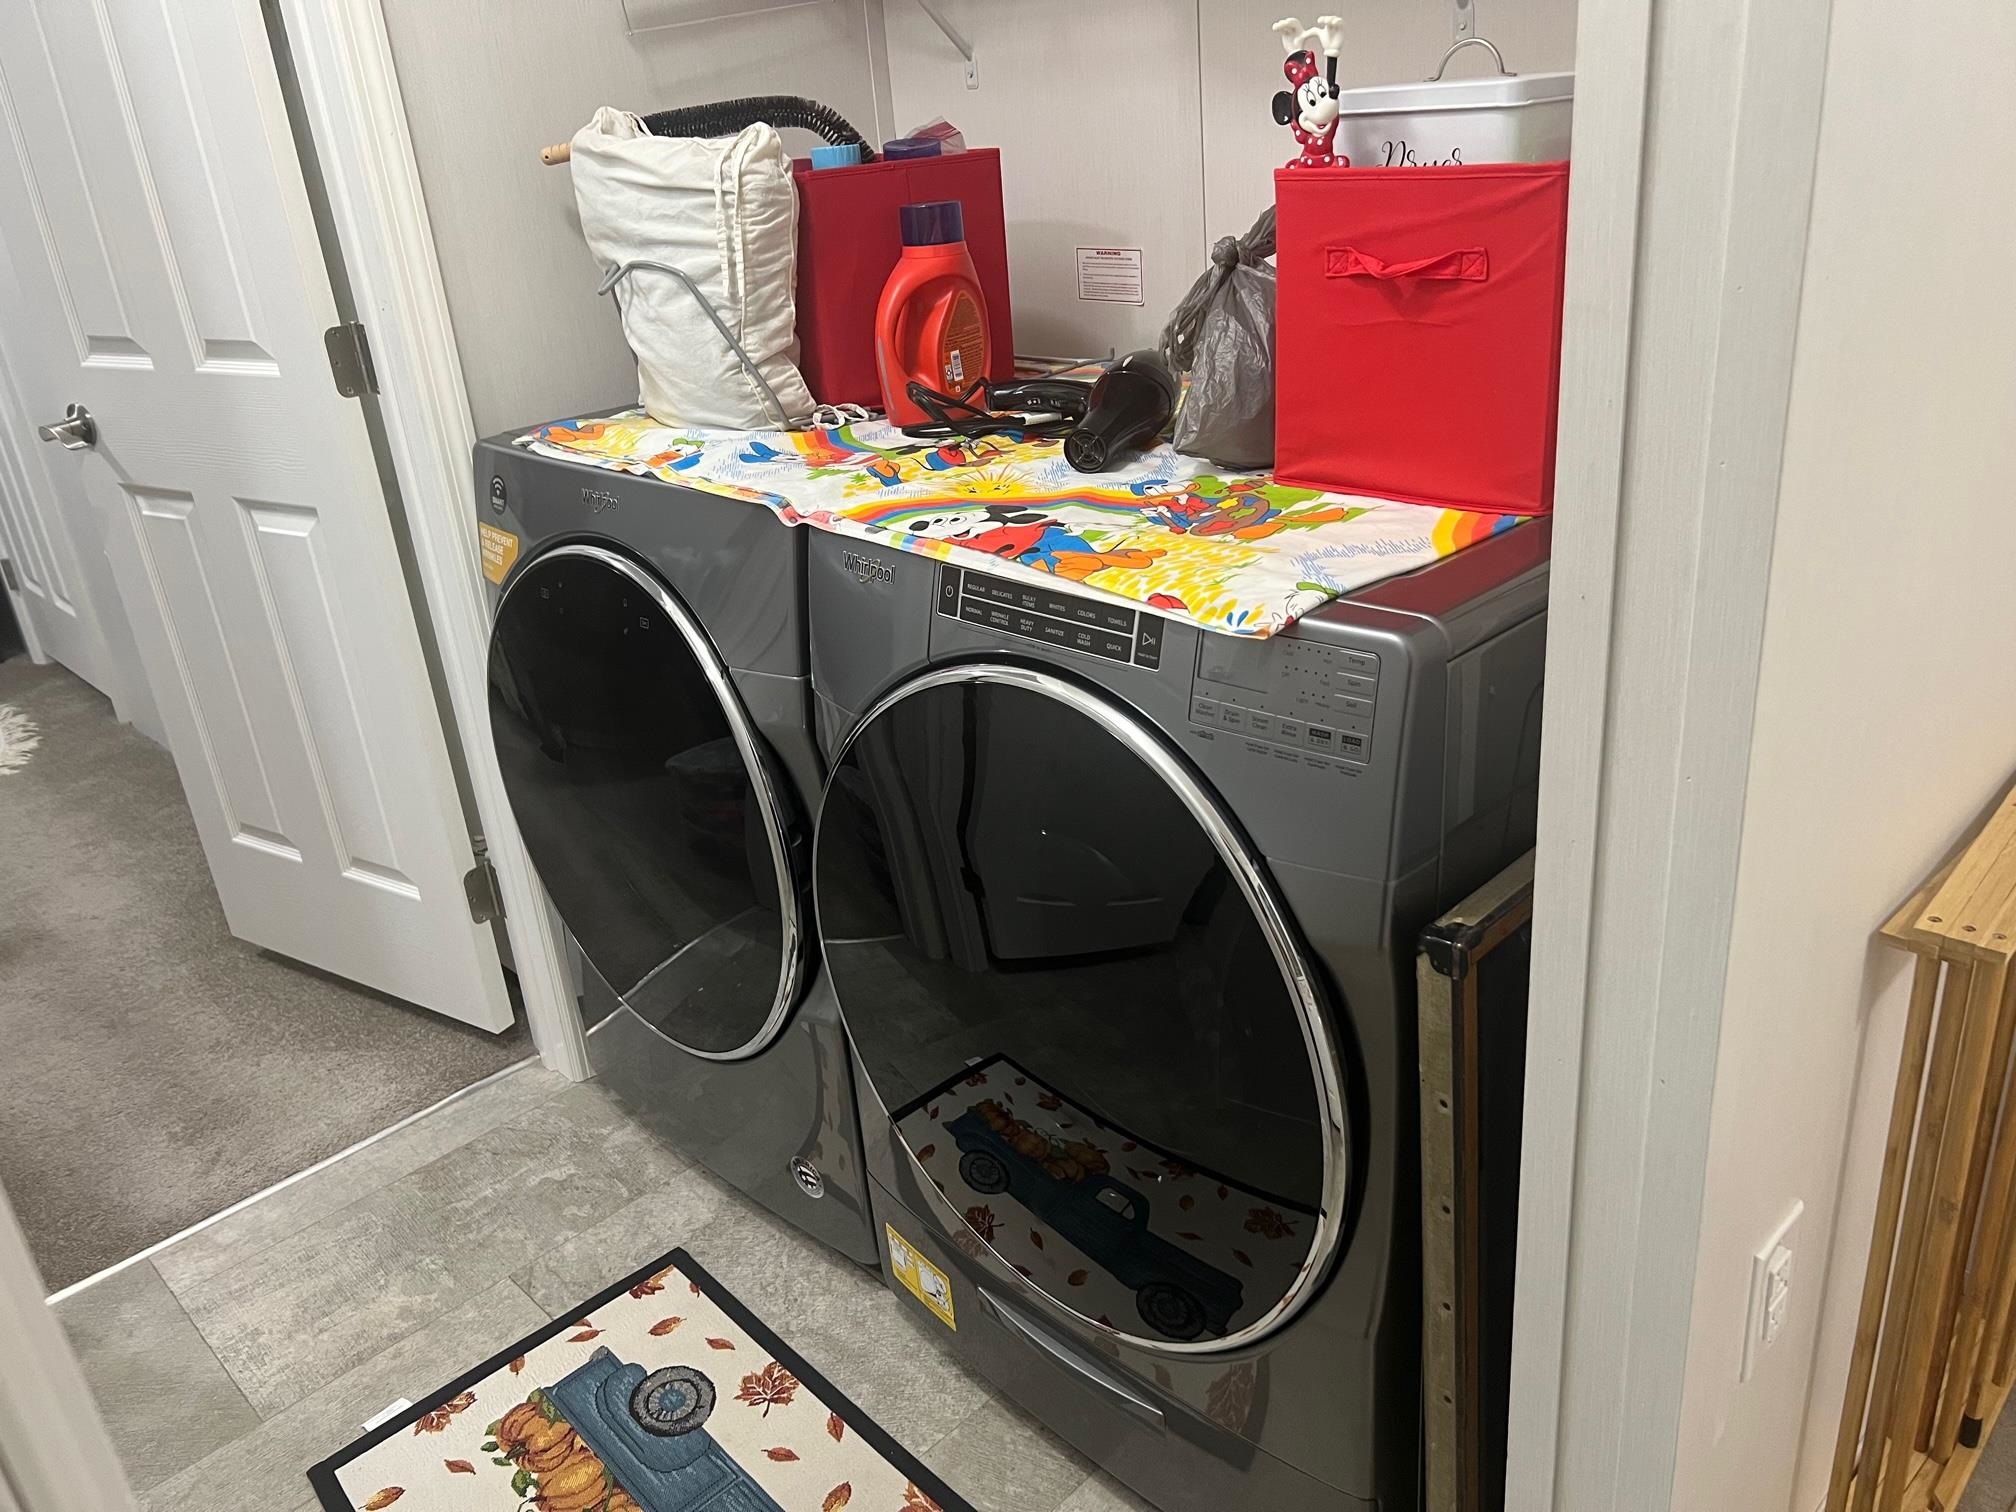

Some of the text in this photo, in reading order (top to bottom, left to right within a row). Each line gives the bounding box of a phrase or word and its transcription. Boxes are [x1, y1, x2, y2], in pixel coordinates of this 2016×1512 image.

[491, 531, 513, 548] PREVENT
[843, 550, 897, 585] Whirlpool
[967, 583, 986, 593] REGULAR
[991, 589, 1013, 600] DELICATES
[1022, 594, 1036, 602] BULKY
[1021, 600, 1035, 609] ITEMS
[1048, 603, 1066, 612] WHITES
[965, 606, 982, 616] NORMAL
[991, 610, 1009, 620] WRINKLE
[1077, 609, 1096, 619] COLORS
[989, 616, 1009, 626] CONTROL
[1020, 618, 1034, 627] HEAVY
[1107, 617, 1127, 627] TOWELS
[1020, 624, 1033, 633] DUTY
[1044, 626, 1064, 637] SANITIZE
[1077, 632, 1091, 641] COLD
[1077, 638, 1091, 647] WASH
[1106, 642, 1122, 652] QUICK
[1348, 656, 1366, 666] Temp
